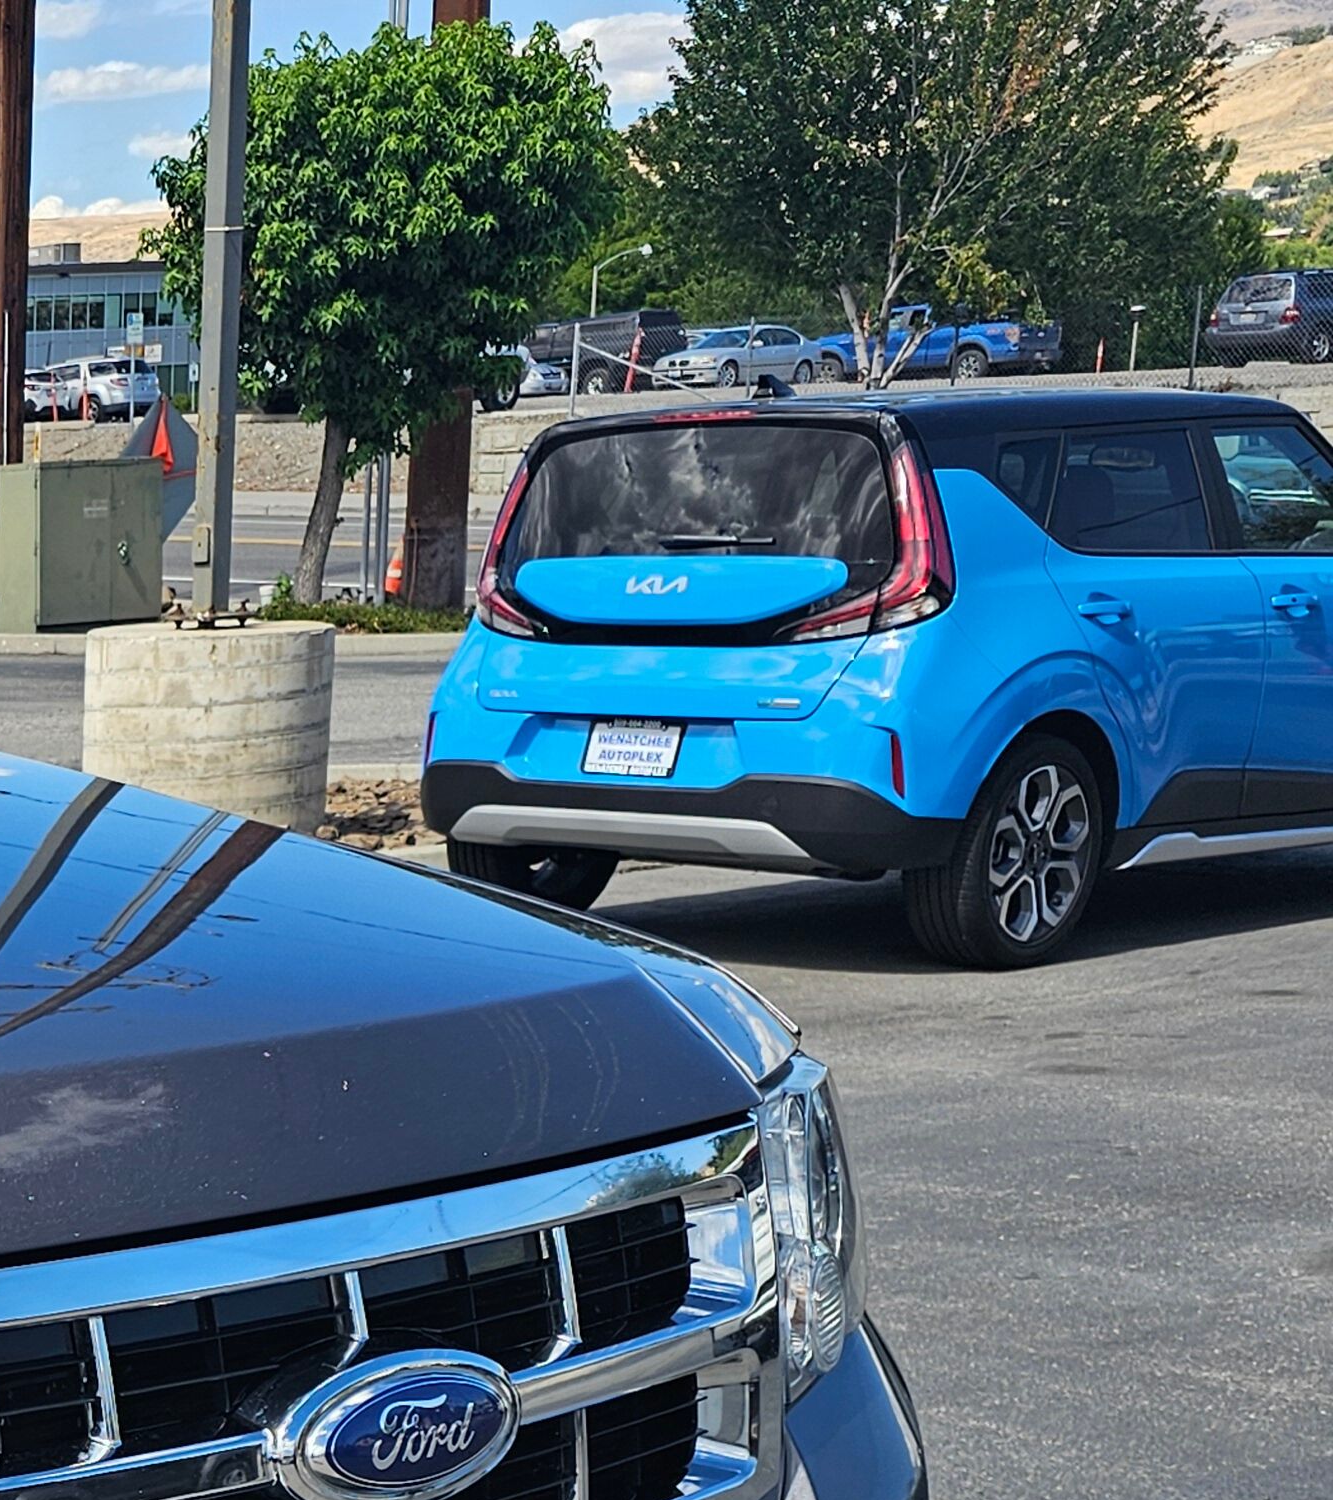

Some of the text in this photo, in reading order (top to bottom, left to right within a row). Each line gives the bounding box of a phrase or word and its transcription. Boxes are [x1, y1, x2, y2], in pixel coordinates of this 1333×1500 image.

[625, 574, 688, 594] KIA
[598, 732, 673, 748] WENATCHEE
[598, 749, 664, 763] AUTOPLEX
[371, 1393, 475, 1471] Ford
